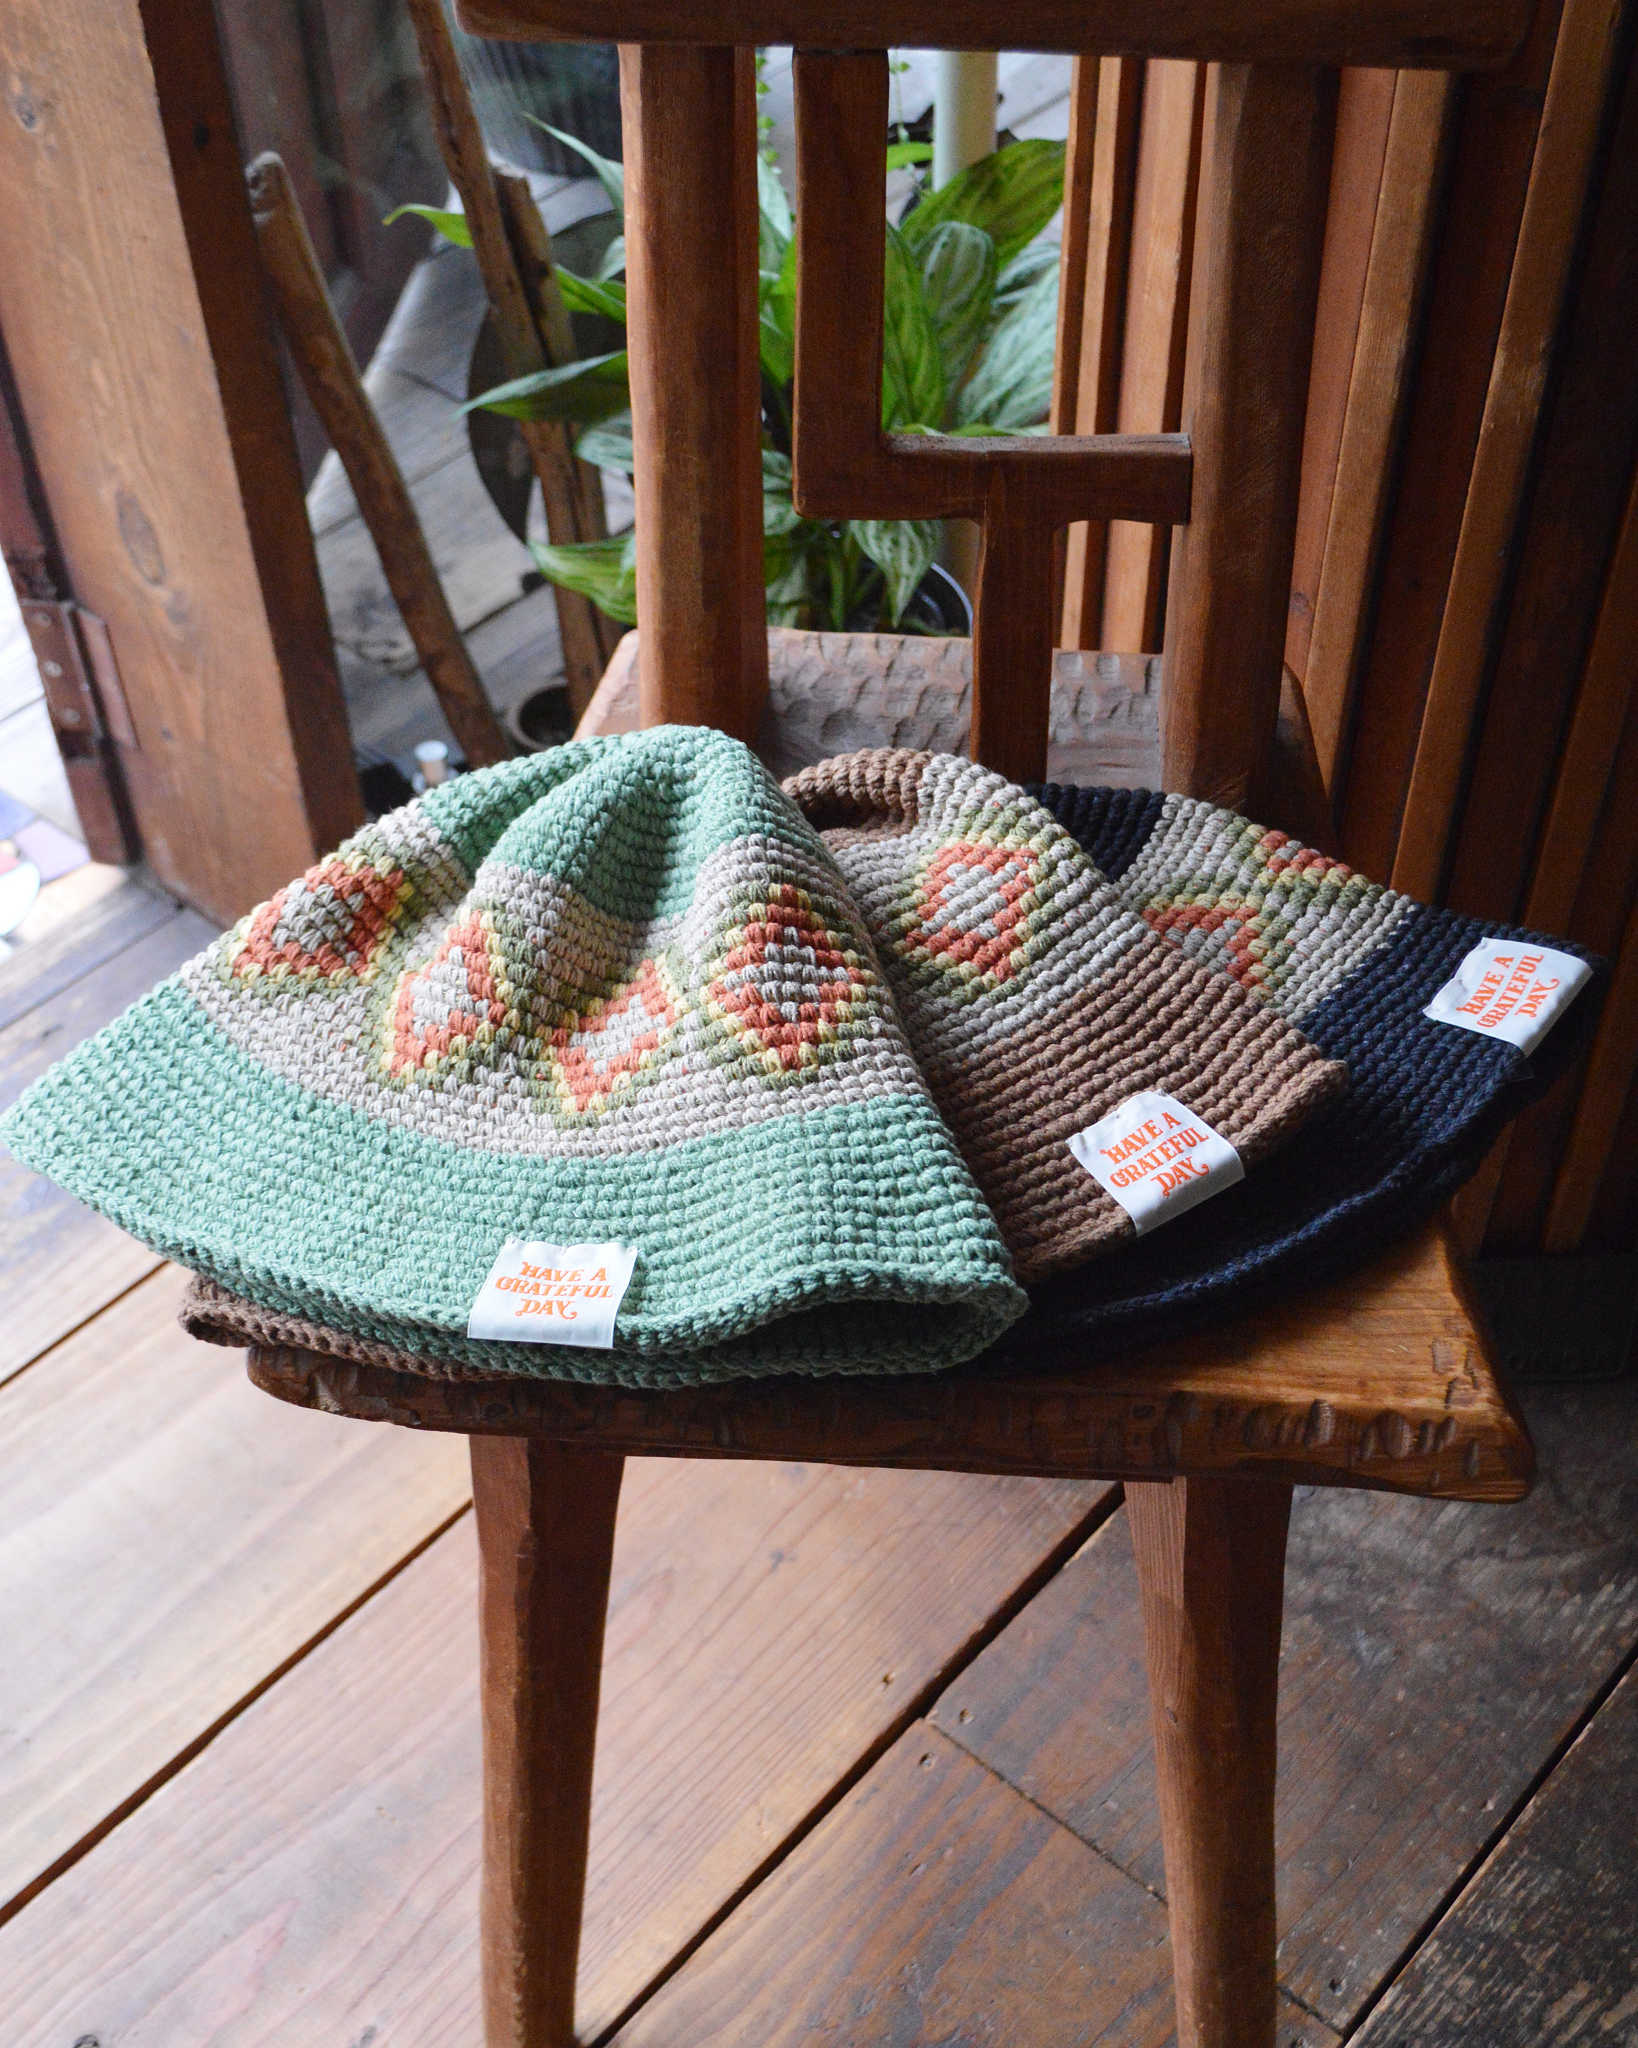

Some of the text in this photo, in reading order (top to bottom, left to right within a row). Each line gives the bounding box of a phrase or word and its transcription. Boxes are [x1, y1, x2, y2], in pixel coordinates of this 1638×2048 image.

[1455, 956, 1515, 1015] HAVE A
[1476, 954, 1544, 1028] GRATEFUL
[1514, 978, 1560, 1017] DAY
[1099, 1111, 1182, 1164] HAVE A
[1109, 1127, 1209, 1188] GRATEFUL
[1150, 1156, 1209, 1197] DAY
[495, 1276, 613, 1298] GRATEFUL
[519, 1261, 607, 1282] HAVE A
[515, 1298, 578, 1320] DAY
